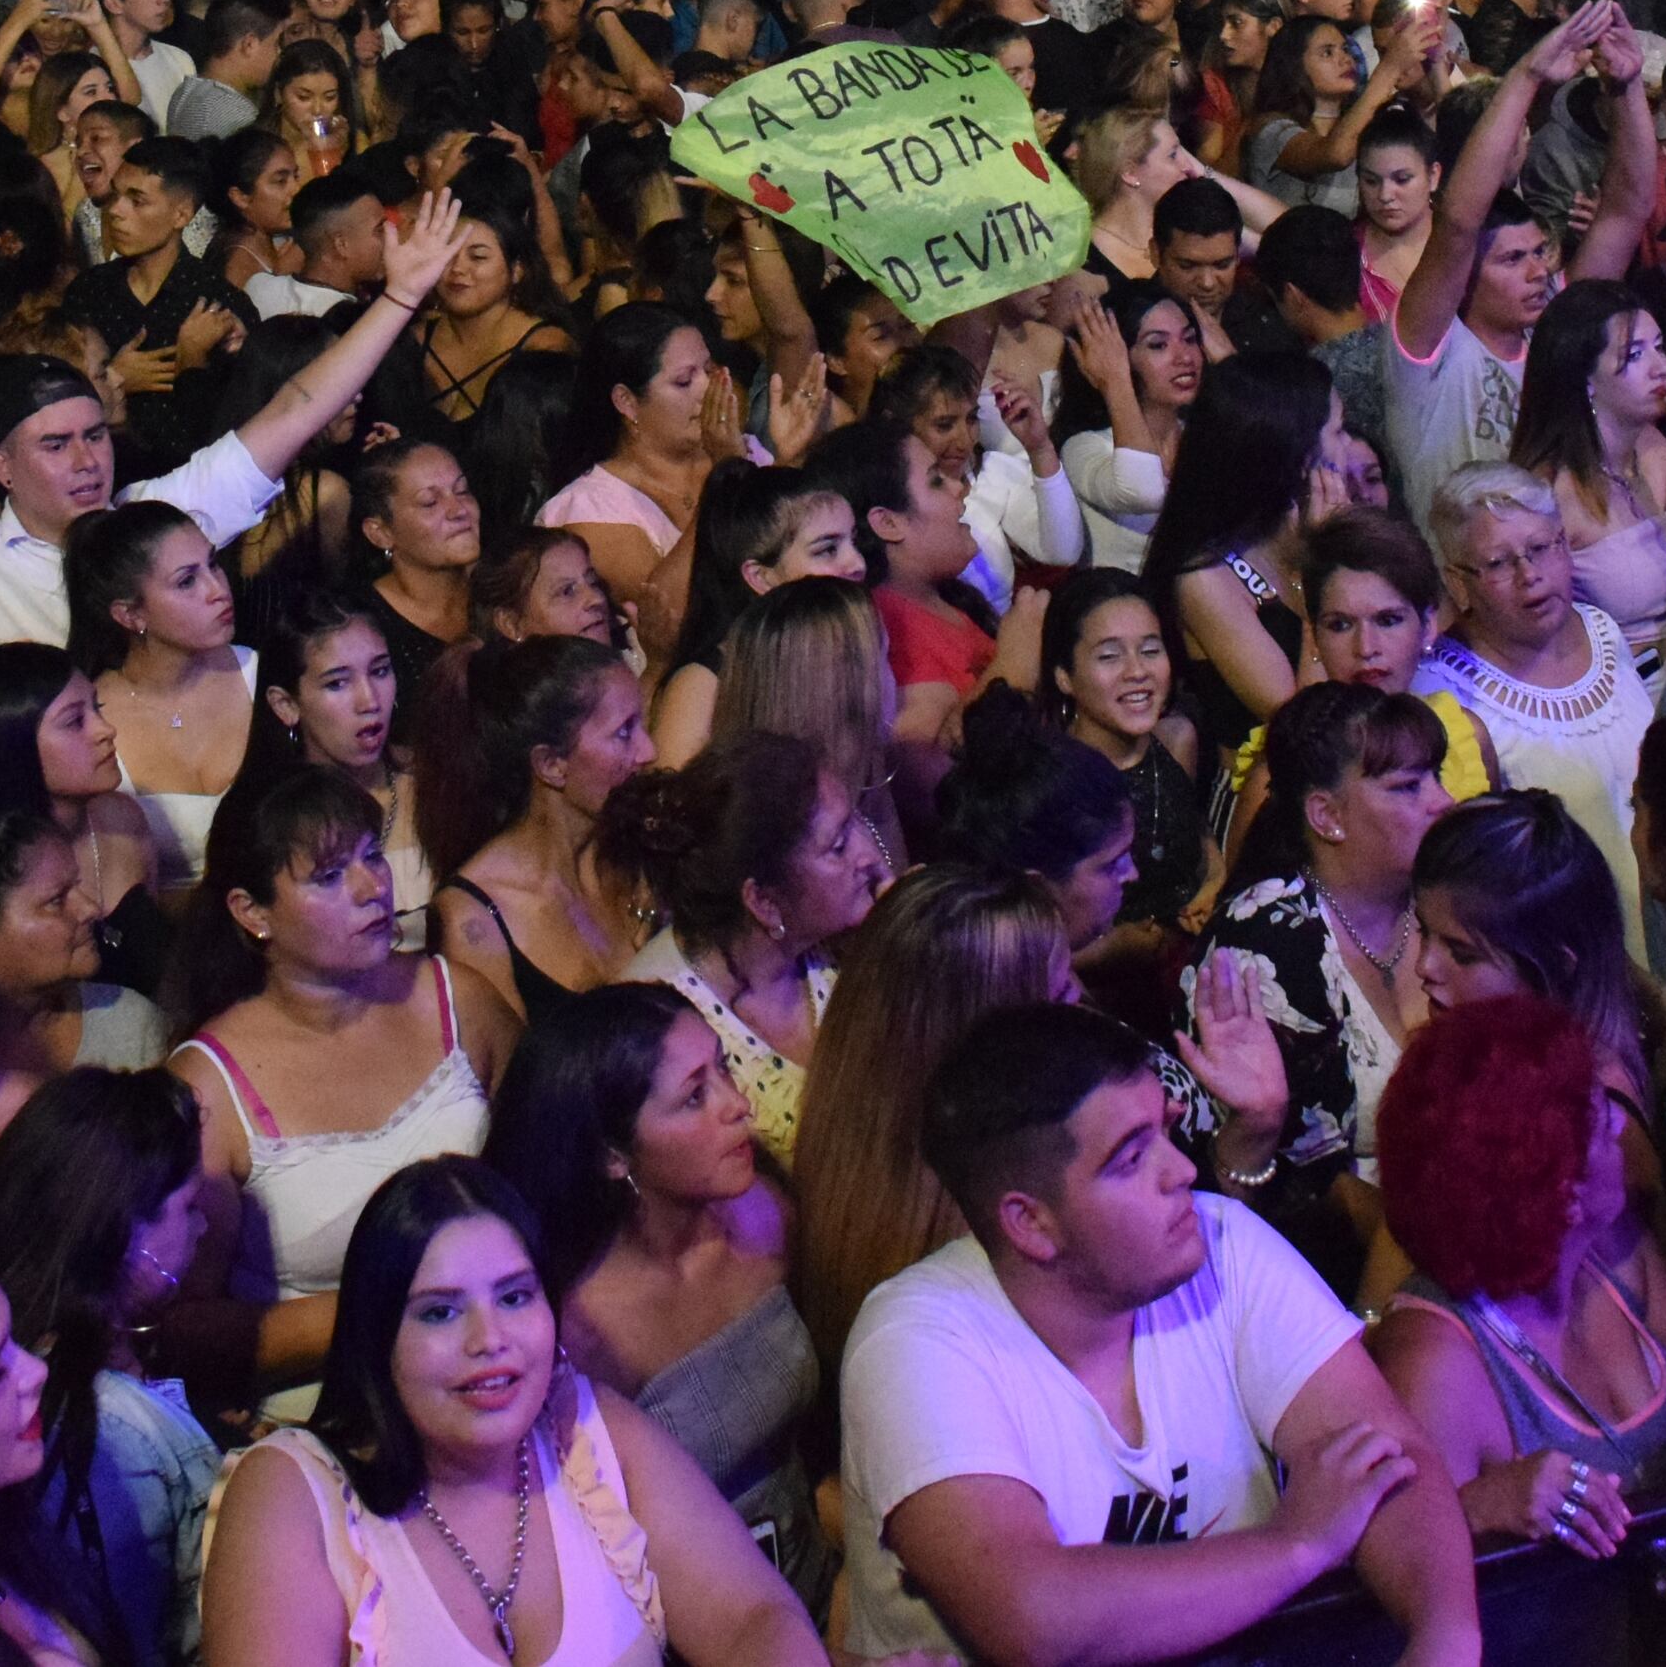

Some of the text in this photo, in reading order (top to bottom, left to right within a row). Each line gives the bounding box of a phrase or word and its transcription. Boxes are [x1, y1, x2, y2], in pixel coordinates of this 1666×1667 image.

[695, 96, 794, 154] LA
[787, 47, 950, 120] BANDA
[822, 169, 868, 220] A
[1102, 1461, 1189, 1544] NIE
